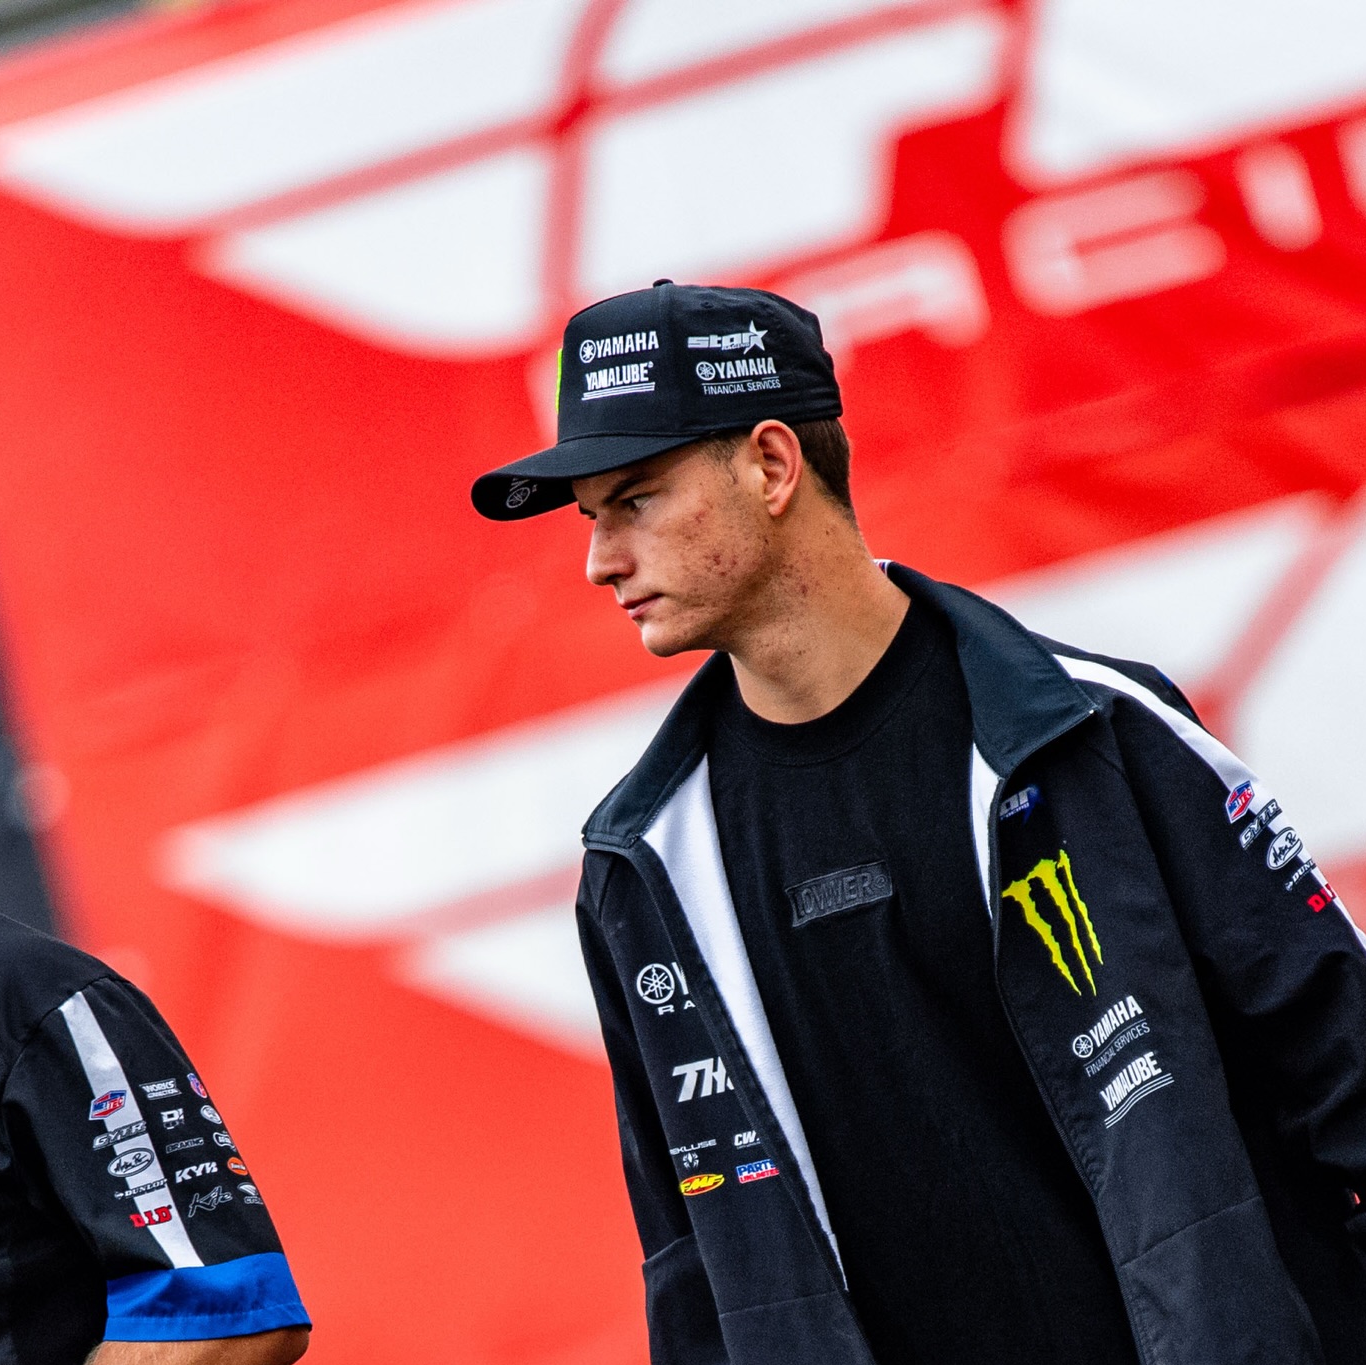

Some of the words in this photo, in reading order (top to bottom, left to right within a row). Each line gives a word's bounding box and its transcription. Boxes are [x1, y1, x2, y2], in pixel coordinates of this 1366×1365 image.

[596, 331, 659, 358] YAMAHA
[714, 357, 777, 379] YAMAHA
[703, 383, 746, 395] FINANCIAL
[746, 379, 782, 392] SERVICES
[1089, 995, 1143, 1047] YAMAHA
[1085, 1047, 1116, 1077] FINANCIAL
[1115, 1022, 1151, 1052] SERVICES
[671, 1056, 734, 1103] TH
[1100, 1051, 1162, 1112] YAMALUBE
[734, 1130, 760, 1146] CW
[175, 1161, 218, 1184] KYB
[124, 1178, 168, 1197] DUNLOP
